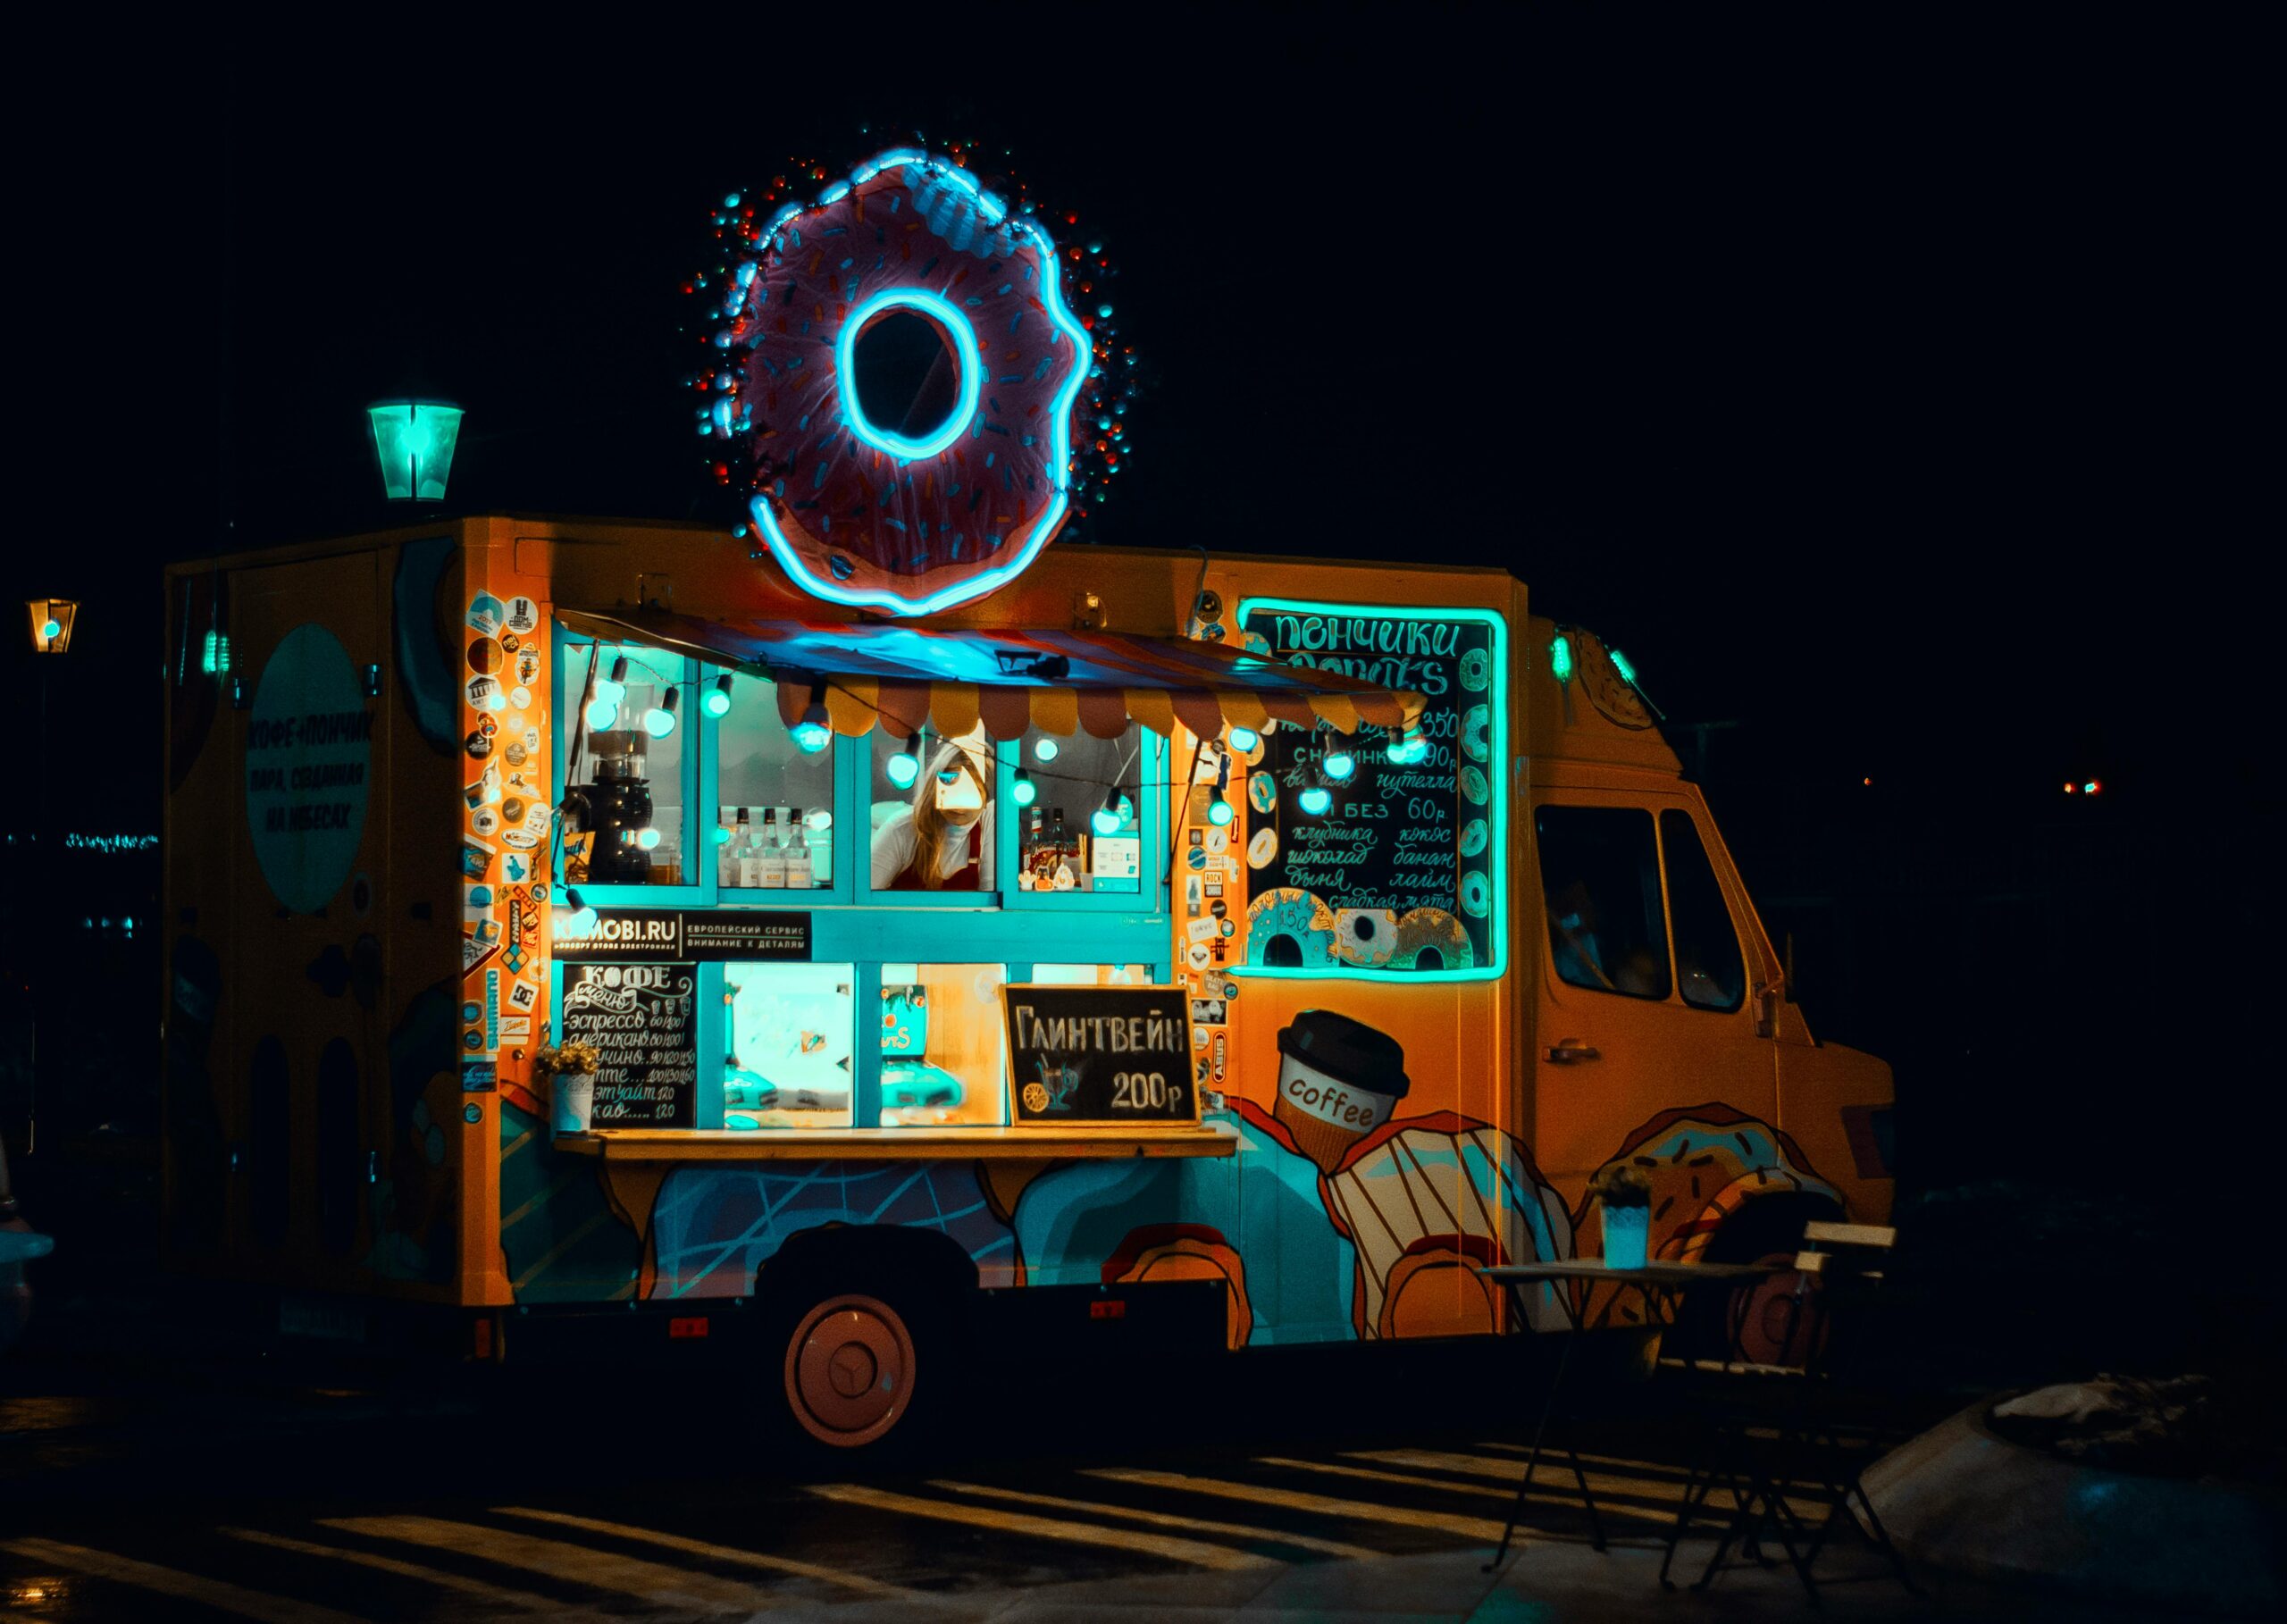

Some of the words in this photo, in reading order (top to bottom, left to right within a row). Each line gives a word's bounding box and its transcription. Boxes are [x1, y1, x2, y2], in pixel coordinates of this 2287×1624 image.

[1377, 770, 1457, 799] нутелла
[1345, 803, 1389, 818] БЕЗ
[1292, 820, 1378, 849] клубника
[1399, 828, 1452, 843] кокос
[1286, 842, 1376, 865] шоколад
[1393, 842, 1456, 868] банан
[1285, 866, 1352, 891] дыня
[1389, 868, 1456, 893] лайм
[1328, 887, 1402, 909] сладкая
[1402, 893, 1457, 914] мята
[554, 919, 675, 941] KMOBI.RU
[687, 925, 761, 934] ЕВРОПЕЙСКИЙ
[765, 926, 804, 935] СЕРВИС
[687, 939, 741, 948] ВНИМАНИЕ
[758, 940, 804, 950] ДЕТАЛЯМ
[582, 966, 671, 988] КОФЕ
[487, 970, 498, 1049] SHIMANO
[580, 985, 629, 1010] меню
[657, 1085, 675, 1101] 120
[1288, 1078, 1374, 1127] coffee
[655, 1103, 675, 1119] 120
